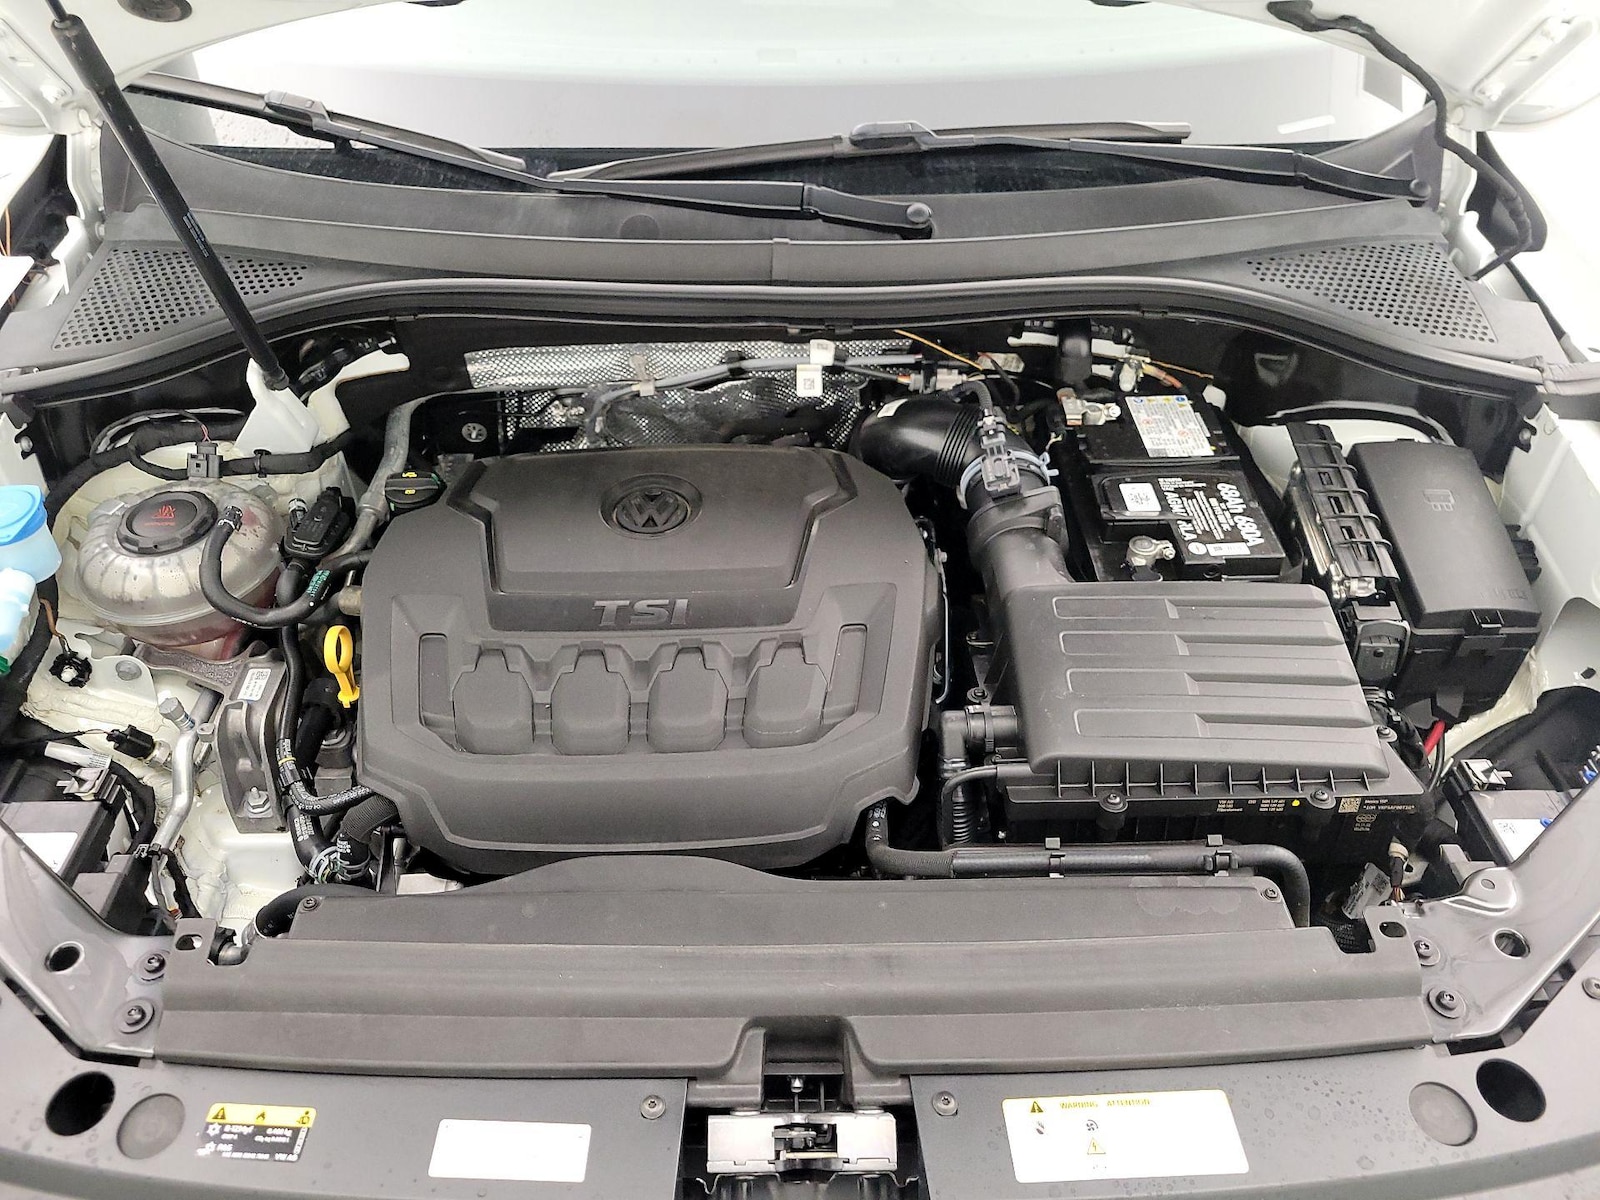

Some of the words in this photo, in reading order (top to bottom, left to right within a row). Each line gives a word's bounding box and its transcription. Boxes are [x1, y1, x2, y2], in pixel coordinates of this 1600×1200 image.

[1217, 483, 1246, 513] 68Ah
[1234, 515, 1264, 547] 680A
[592, 598, 690, 627] TSI
